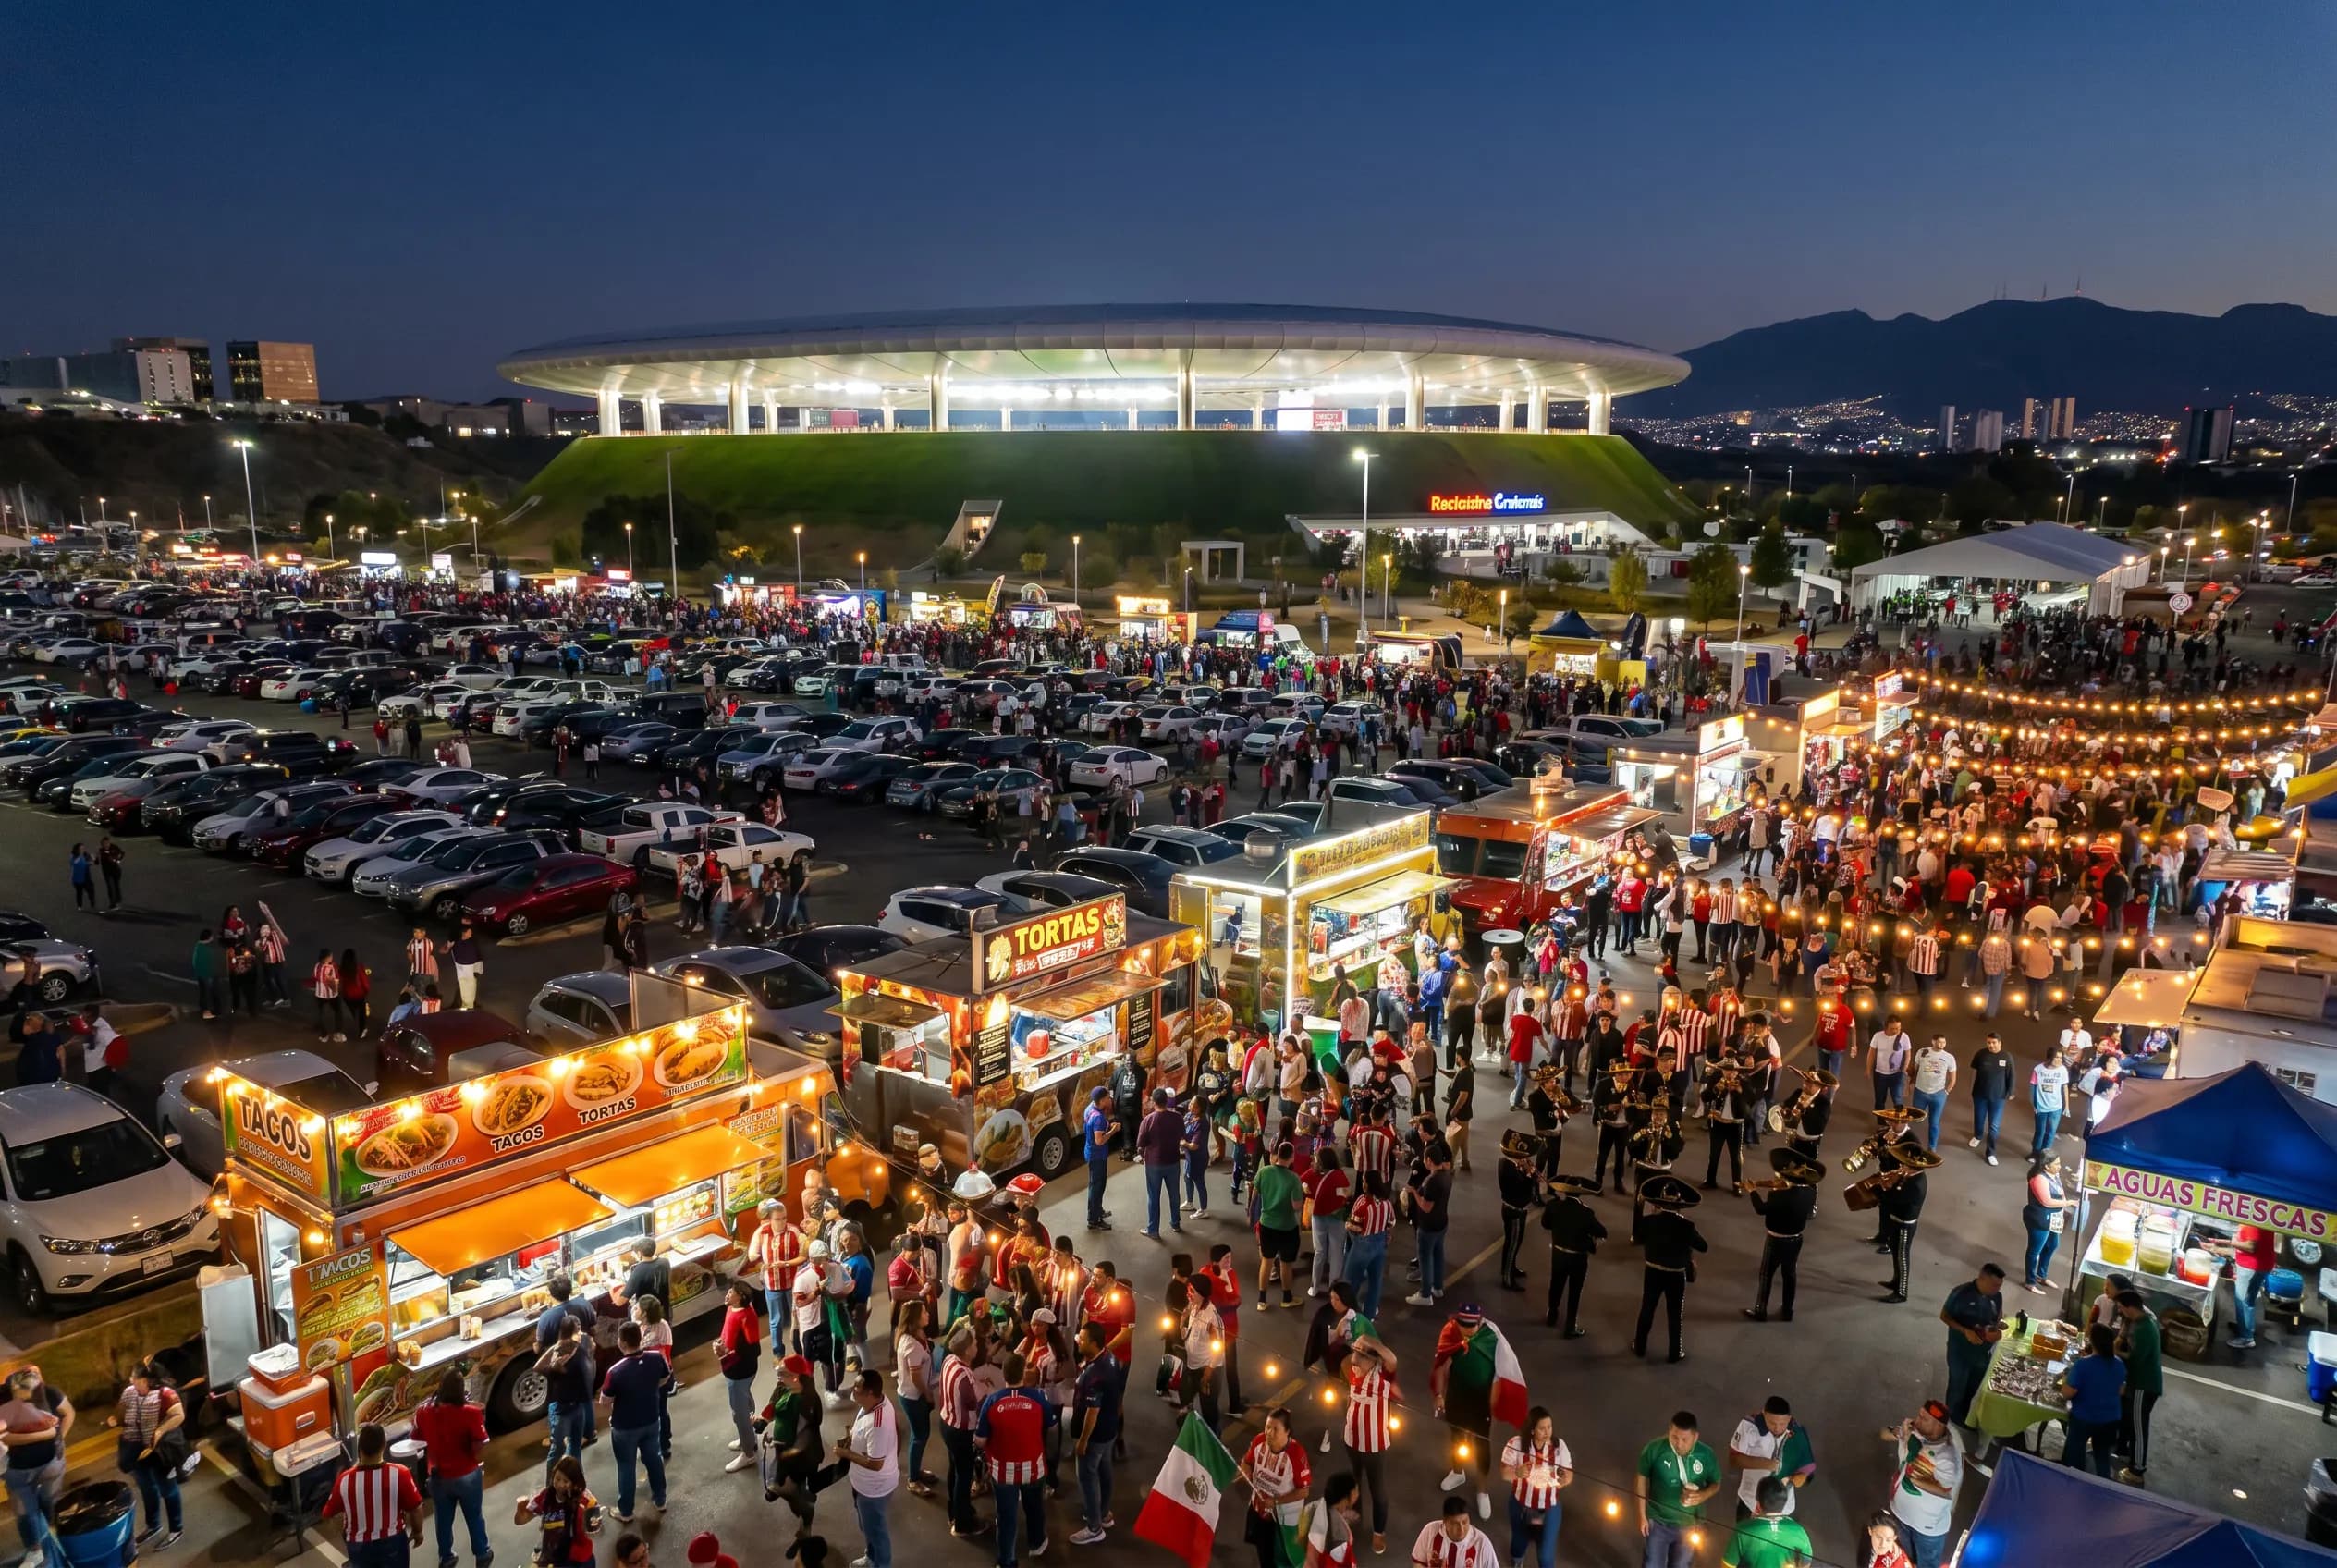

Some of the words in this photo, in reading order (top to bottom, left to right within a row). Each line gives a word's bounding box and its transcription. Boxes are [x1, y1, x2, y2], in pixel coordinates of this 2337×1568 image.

[1015, 907, 1100, 956] TORTAS
[237, 1095, 312, 1163] TACOS
[578, 1096, 637, 1125] TORTAS
[491, 1124, 544, 1154] TACOS
[2103, 1167, 2195, 1206] AGUAS
[2201, 1186, 2328, 1237] FRESCAS
